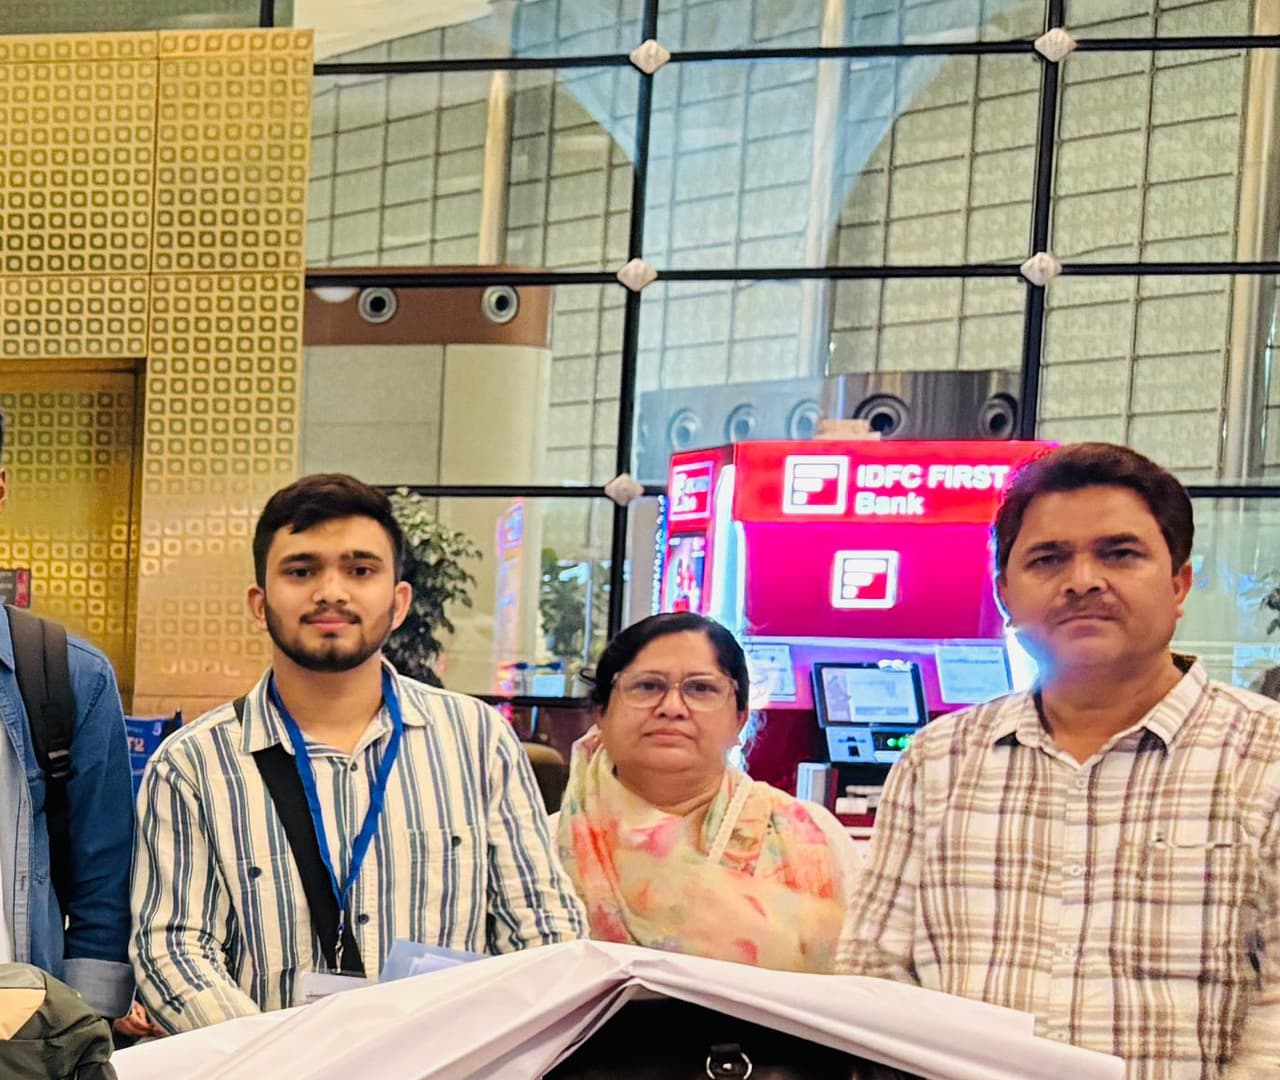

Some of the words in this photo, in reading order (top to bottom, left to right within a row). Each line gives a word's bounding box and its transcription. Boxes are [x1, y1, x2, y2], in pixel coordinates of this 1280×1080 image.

[856, 464, 923, 489] IDFC
[927, 464, 1010, 490] FIRST
[854, 491, 926, 515] Bank
